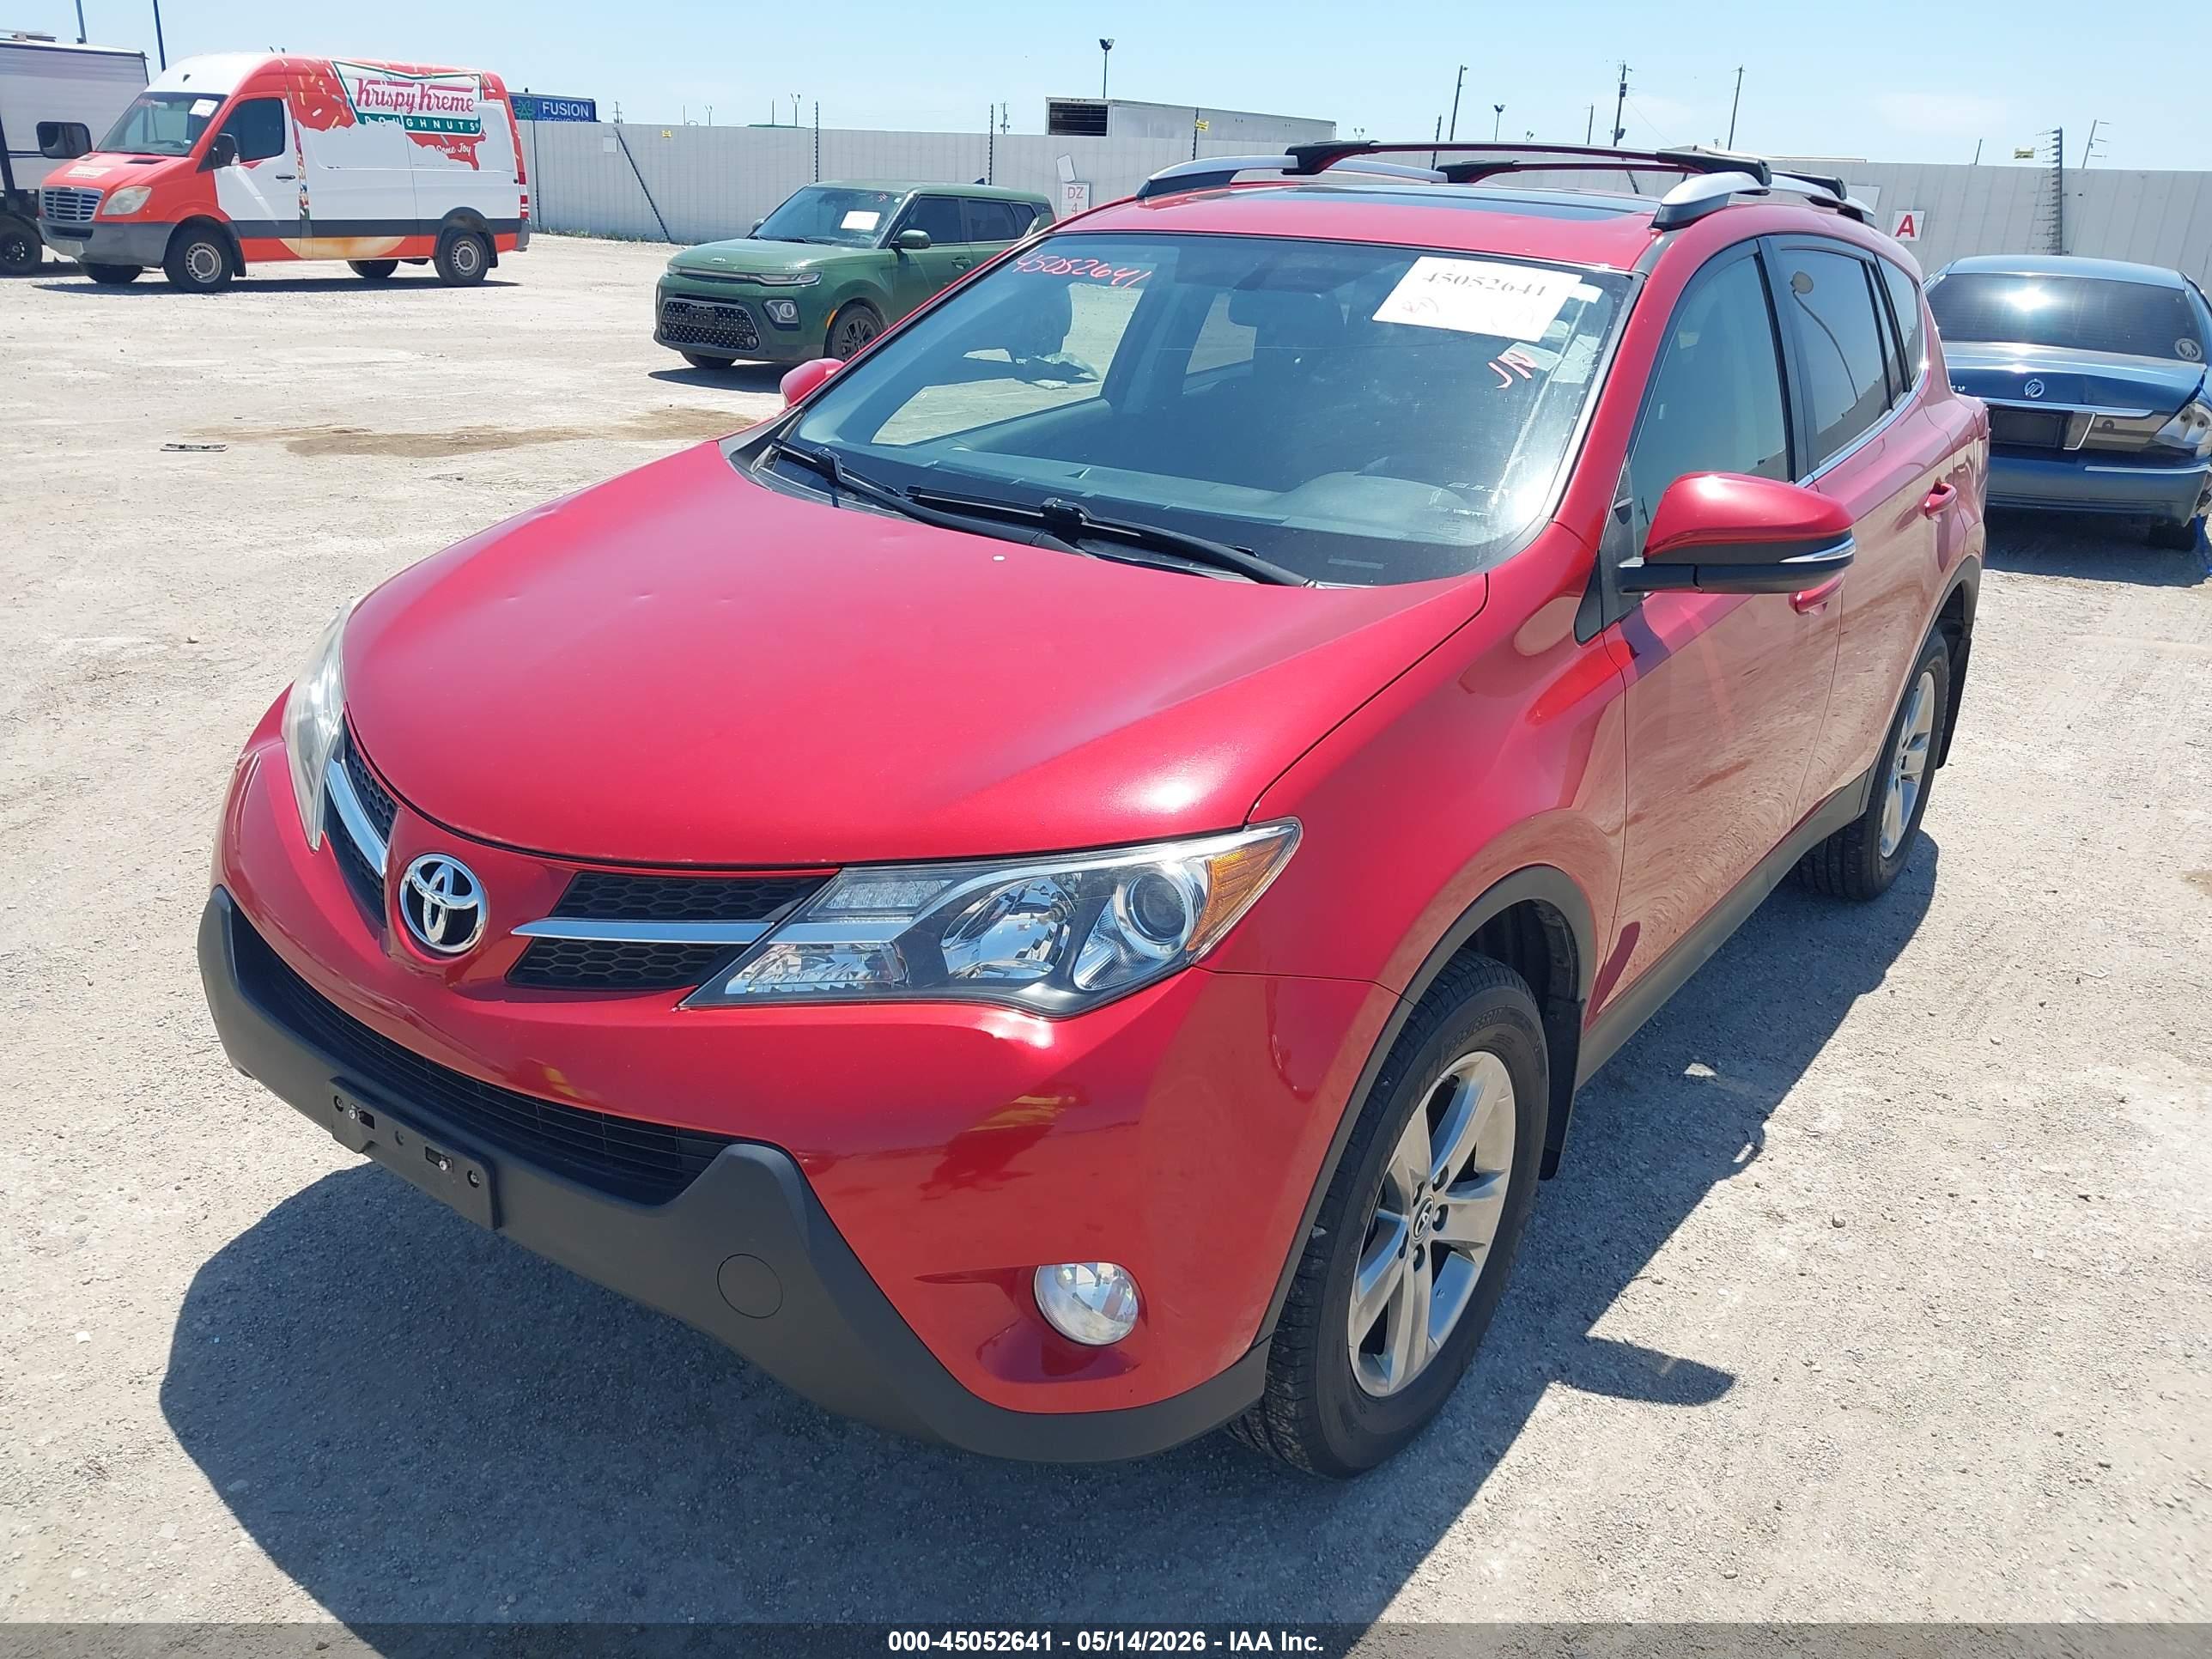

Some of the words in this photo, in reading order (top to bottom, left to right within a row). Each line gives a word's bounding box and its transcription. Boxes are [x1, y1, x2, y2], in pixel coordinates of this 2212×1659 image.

[356, 78, 416, 114] Krispy
[418, 82, 474, 112] Kreme
[542, 101, 589, 118] FUSION
[457, 143, 471, 156] Joy
[1067, 186, 1084, 199] DZ
[1071, 203, 1078, 214] 4
[1895, 215, 1916, 238] A
[1012, 252, 1152, 289] 45052641
[1422, 270, 1547, 296] 45052641
